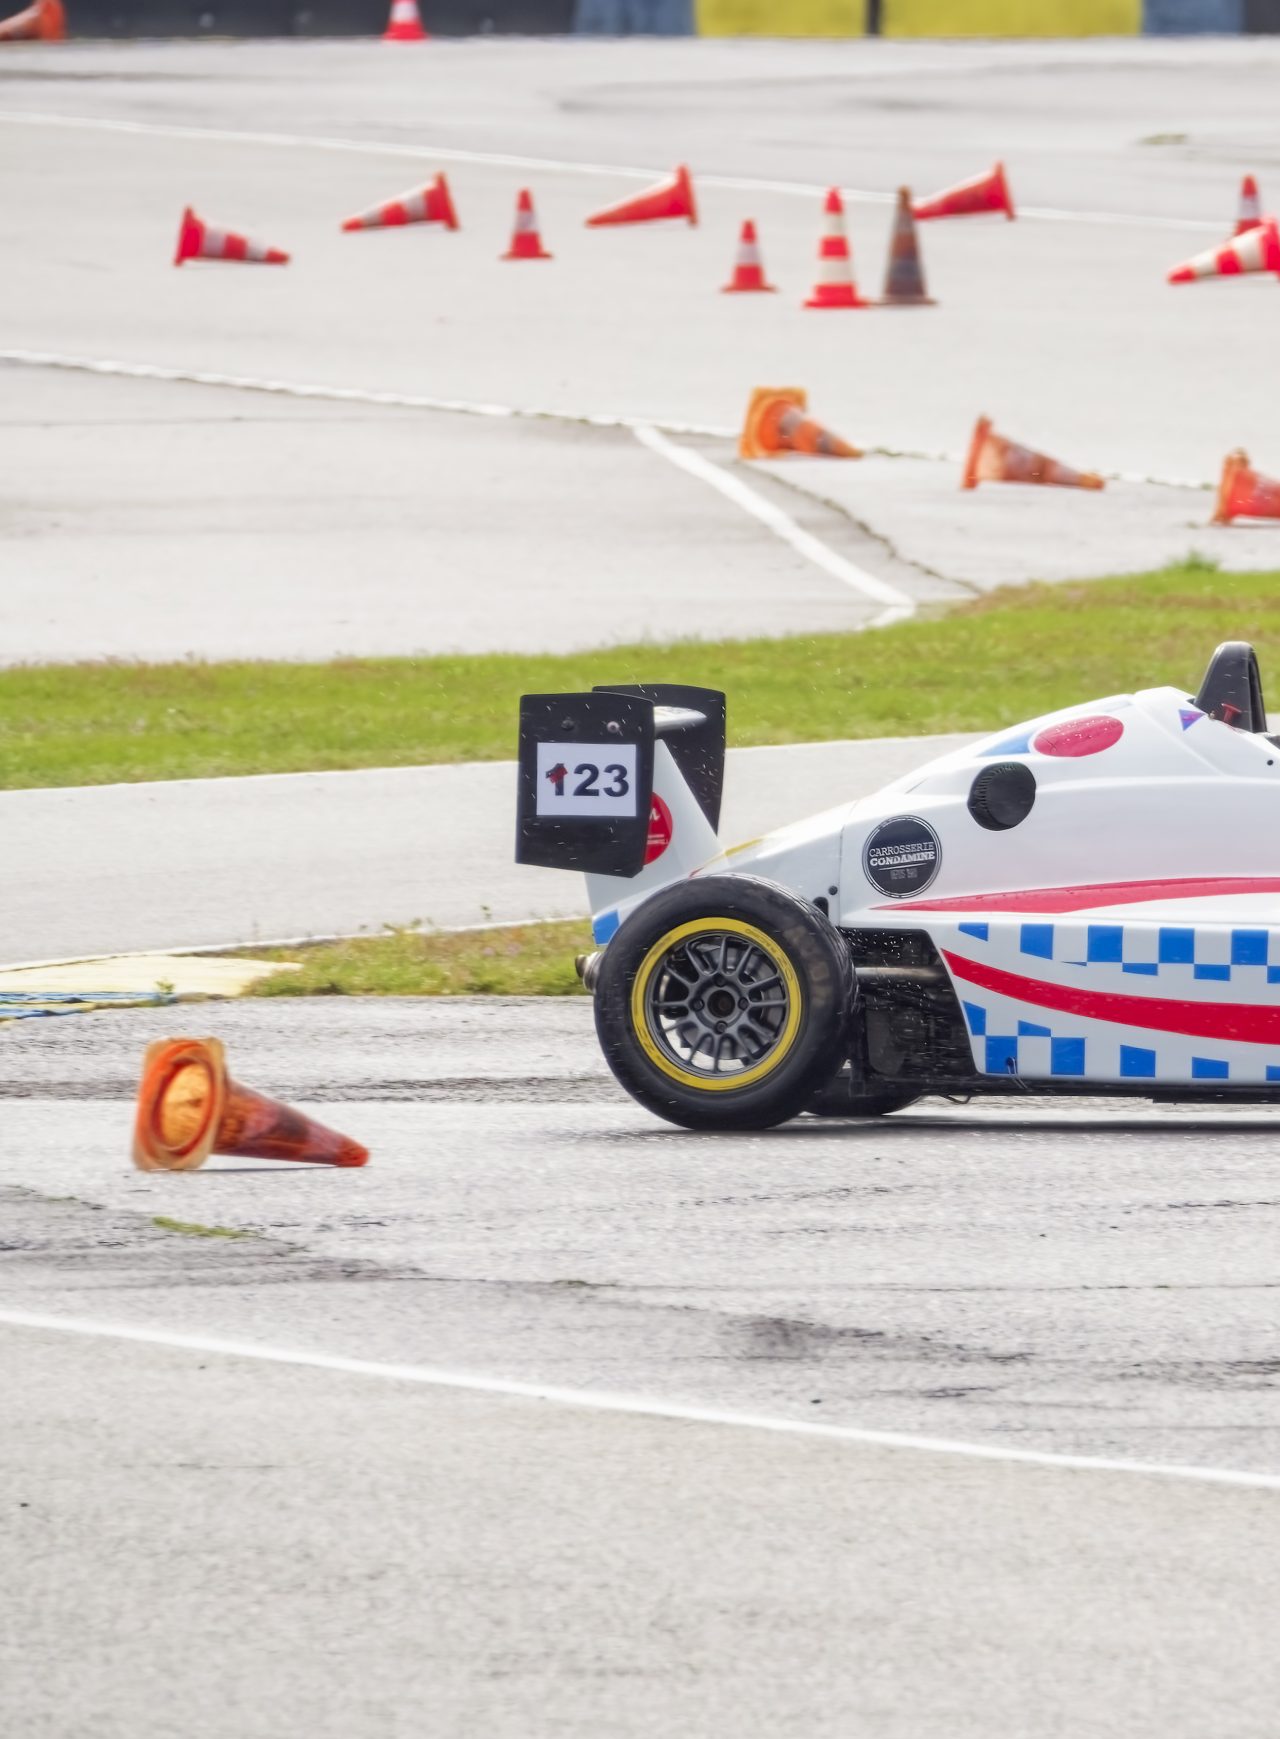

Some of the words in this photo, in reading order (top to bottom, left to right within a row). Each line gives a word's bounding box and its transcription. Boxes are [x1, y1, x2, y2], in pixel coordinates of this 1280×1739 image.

[545, 762, 629, 797] 123
[869, 841, 935, 857] CARROSSERIE
[869, 851, 936, 866] CONDAMINE
